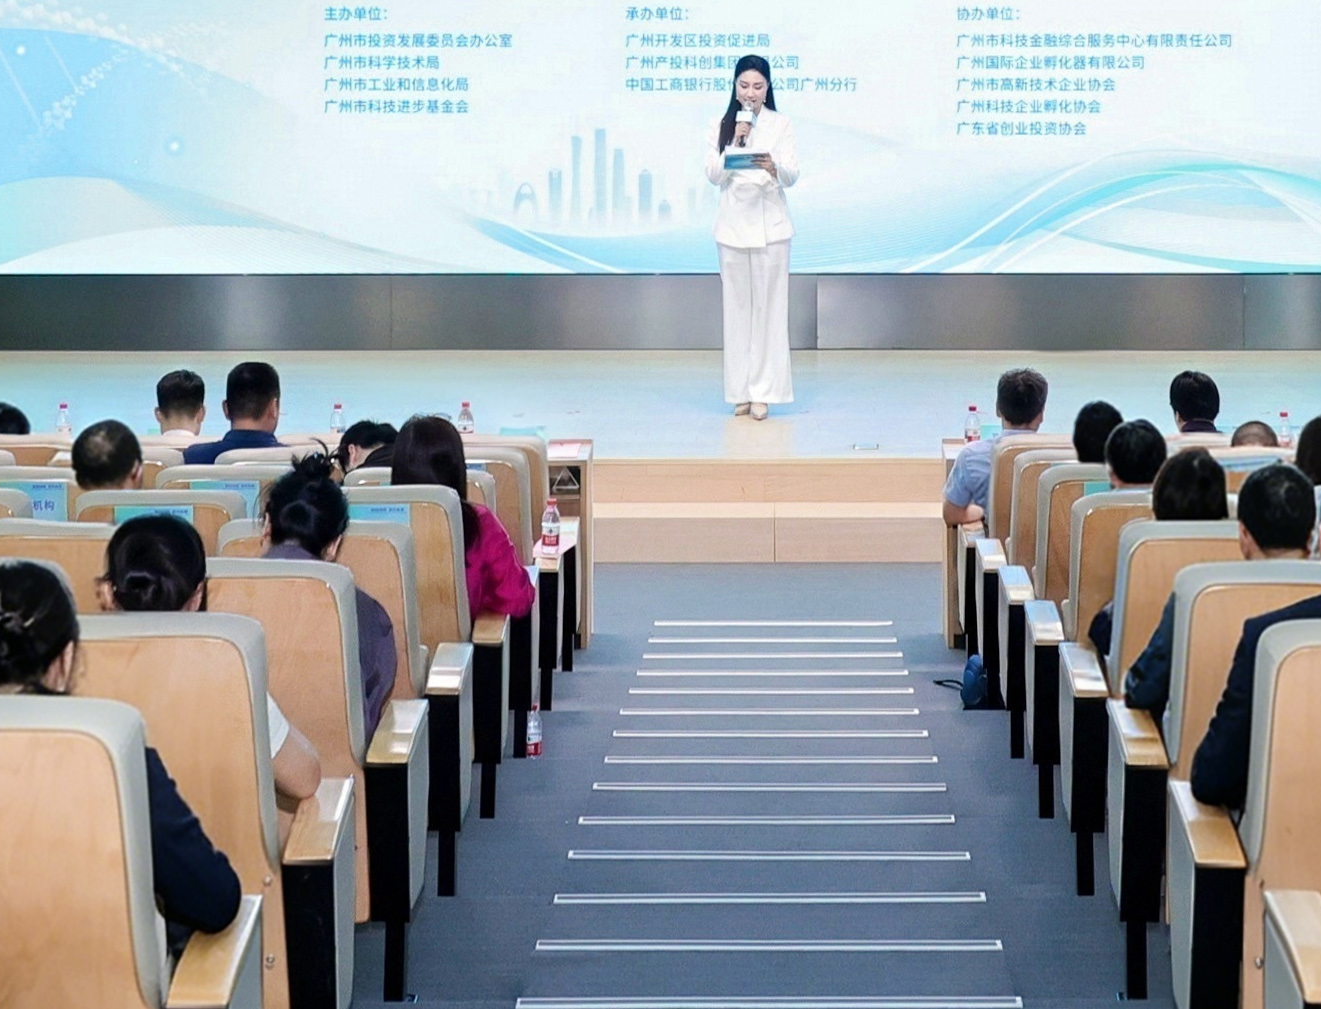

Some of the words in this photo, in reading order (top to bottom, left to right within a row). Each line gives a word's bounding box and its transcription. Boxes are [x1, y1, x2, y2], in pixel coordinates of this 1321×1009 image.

[324, 6, 388, 21] 主办单位：
[626, 6, 689, 21] 承办单位：
[957, 6, 1020, 21] 协办单位：
[324, 33, 513, 48] 广州市投资发展委员会办公室
[625, 33, 770, 48] 广州开发区投资促进局
[956, 33, 1232, 48] 广州市科技金融综合服务中心有限责任公司
[324, 55, 440, 70] 广州市科学技术局
[625, 55, 799, 70] 广州产投科创集团公司
[956, 55, 1145, 70] 广州国际企业孵化器有限公司
[324, 77, 469, 92] 广州市工业和信息化局
[625, 77, 858, 92] 中国工商银行股公司广州分行
[956, 77, 1116, 92] 广州市高新技术企业协会
[324, 99, 469, 114] 广州市科技进步基金会
[956, 99, 1101, 114] 广州科技企业孵化协会
[956, 121, 1087, 136] 广东省创业投资协会
